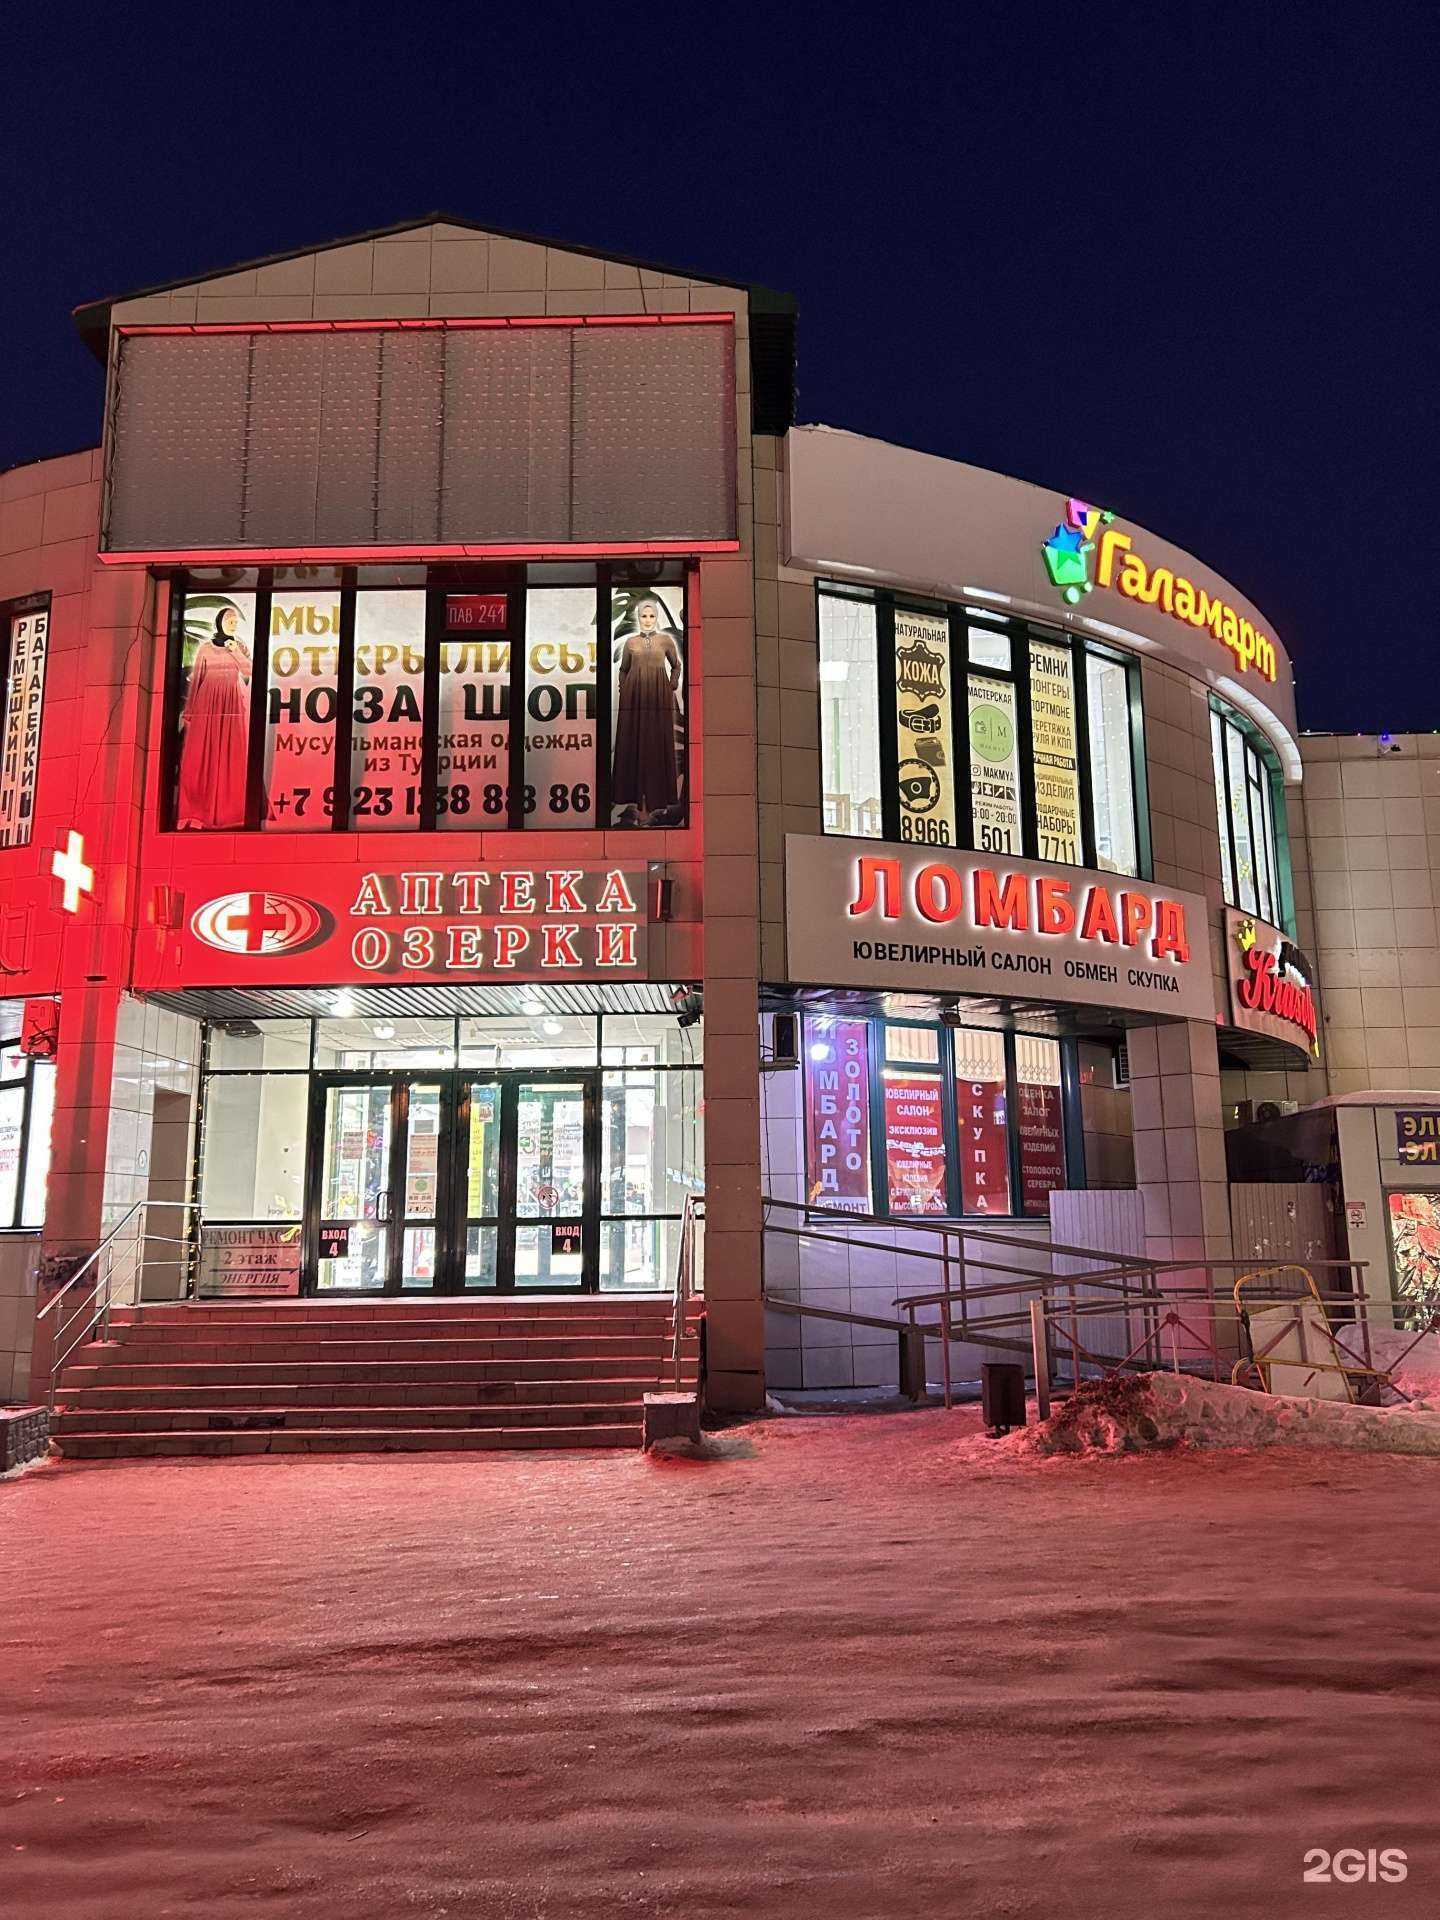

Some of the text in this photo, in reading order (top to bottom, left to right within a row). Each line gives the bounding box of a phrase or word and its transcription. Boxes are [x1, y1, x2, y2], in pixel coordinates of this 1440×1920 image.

[449, 603, 507, 624] ПАВ 241
[1096, 530, 1277, 682] Галамарт
[272, 605, 340, 636] МЫ
[895, 622, 946, 642] НАТУРАЛЬНАЯ
[903, 659, 940, 685] КОЖА
[1030, 652, 1068, 678] РЕМНИ
[7, 621, 28, 750] РЕМЕШКИ
[968, 686, 1012, 704] МАСТЕРСКАЯ
[21, 617, 46, 787] БАТАРЕЙКИ
[268, 684, 597, 724] НОЗА ШОП
[1034, 719, 1071, 738] ЕРЕТЯЖКА
[1033, 733, 1050, 746] УЛЯ
[364, 753, 497, 775] из Турции
[1034, 752, 1053, 765] УЧНАЯ
[274, 787, 312, 816] +7
[549, 783, 591, 813] 86
[902, 815, 950, 845] 8966
[981, 824, 1012, 854] 501
[1040, 835, 1076, 864] 7711
[350, 869, 637, 915] АПТЕКА
[849, 856, 1190, 962] ЛОМБАРД
[351, 923, 637, 969] ОЗЕРКИ
[853, 941, 1179, 993] ЮВЕЛИРНЫЙ САЛОН ОБМЕН СКУПКА
[845, 1038, 862, 1170] ЗОЛОТО
[885, 1088, 940, 1101] ЮВЕЛИРНЫЙ
[896, 1105, 930, 1117] САЛОН
[1023, 1106, 1051, 1117] ЗАЛОГ
[889, 1126, 938, 1136] ЭКСКЛЮЗИВ
[1402, 1116, 1440, 1136] ЭЛ
[971, 1084, 988, 1208] СКУПКА
[1022, 1166, 1062, 1176] СТОЛОВОГО
[1027, 1180, 1057, 1189] СЕРЕБРА
[821, 1201, 867, 1213] ЕМОНТ
[202, 1226, 300, 1245] РЕМОНТ ЧАСВ
[321, 1229, 347, 1240] ВХОД
[555, 1226, 580, 1237] ВХОД
[329, 1242, 339, 1257] 4
[562, 1238, 572, 1253] 4
[223, 1251, 278, 1265] 2 этаж
[222, 1272, 281, 1284] ЭНЕРГИЯ
